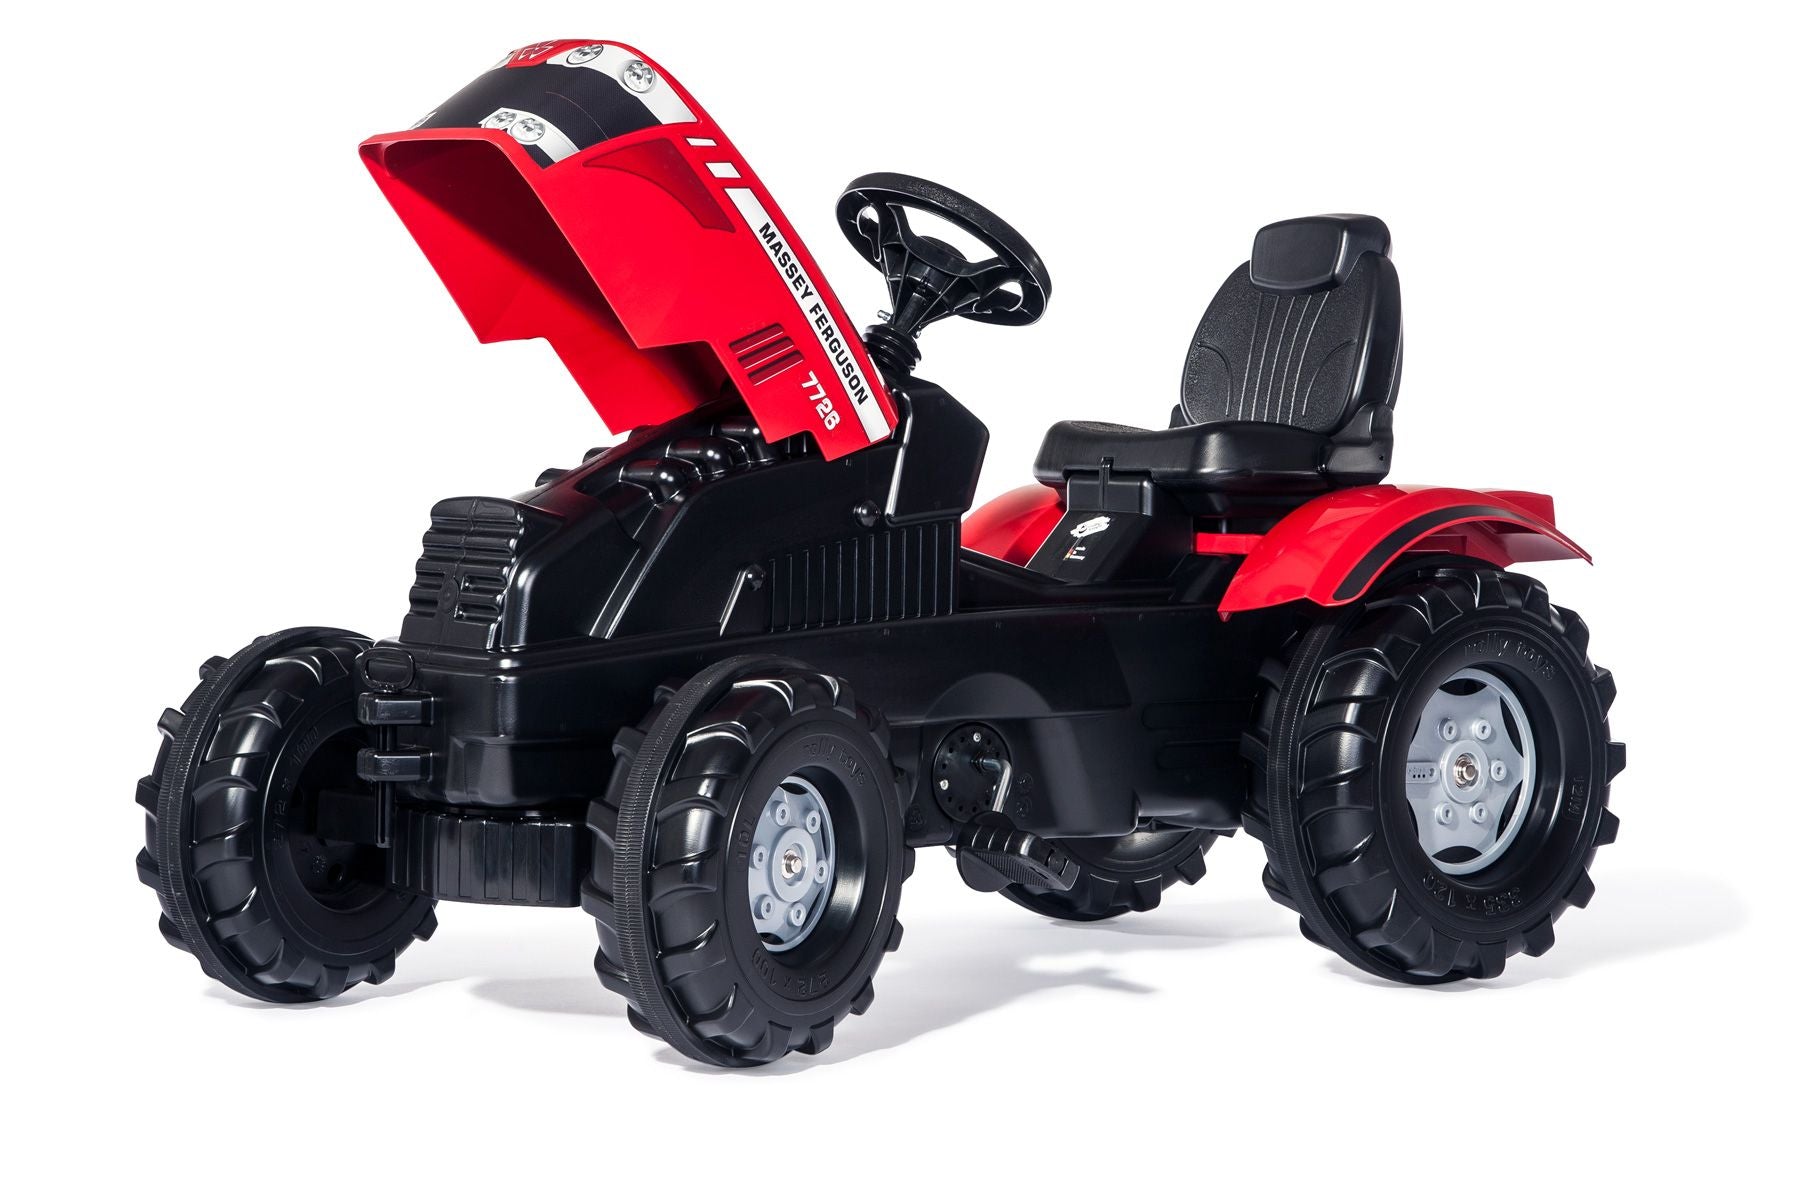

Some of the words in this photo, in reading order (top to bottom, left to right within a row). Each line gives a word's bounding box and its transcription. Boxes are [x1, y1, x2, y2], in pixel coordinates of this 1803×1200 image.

[759, 221, 814, 300] MASSEY
[809, 302, 869, 404] FERGUSON
[801, 370, 841, 430] 7726
